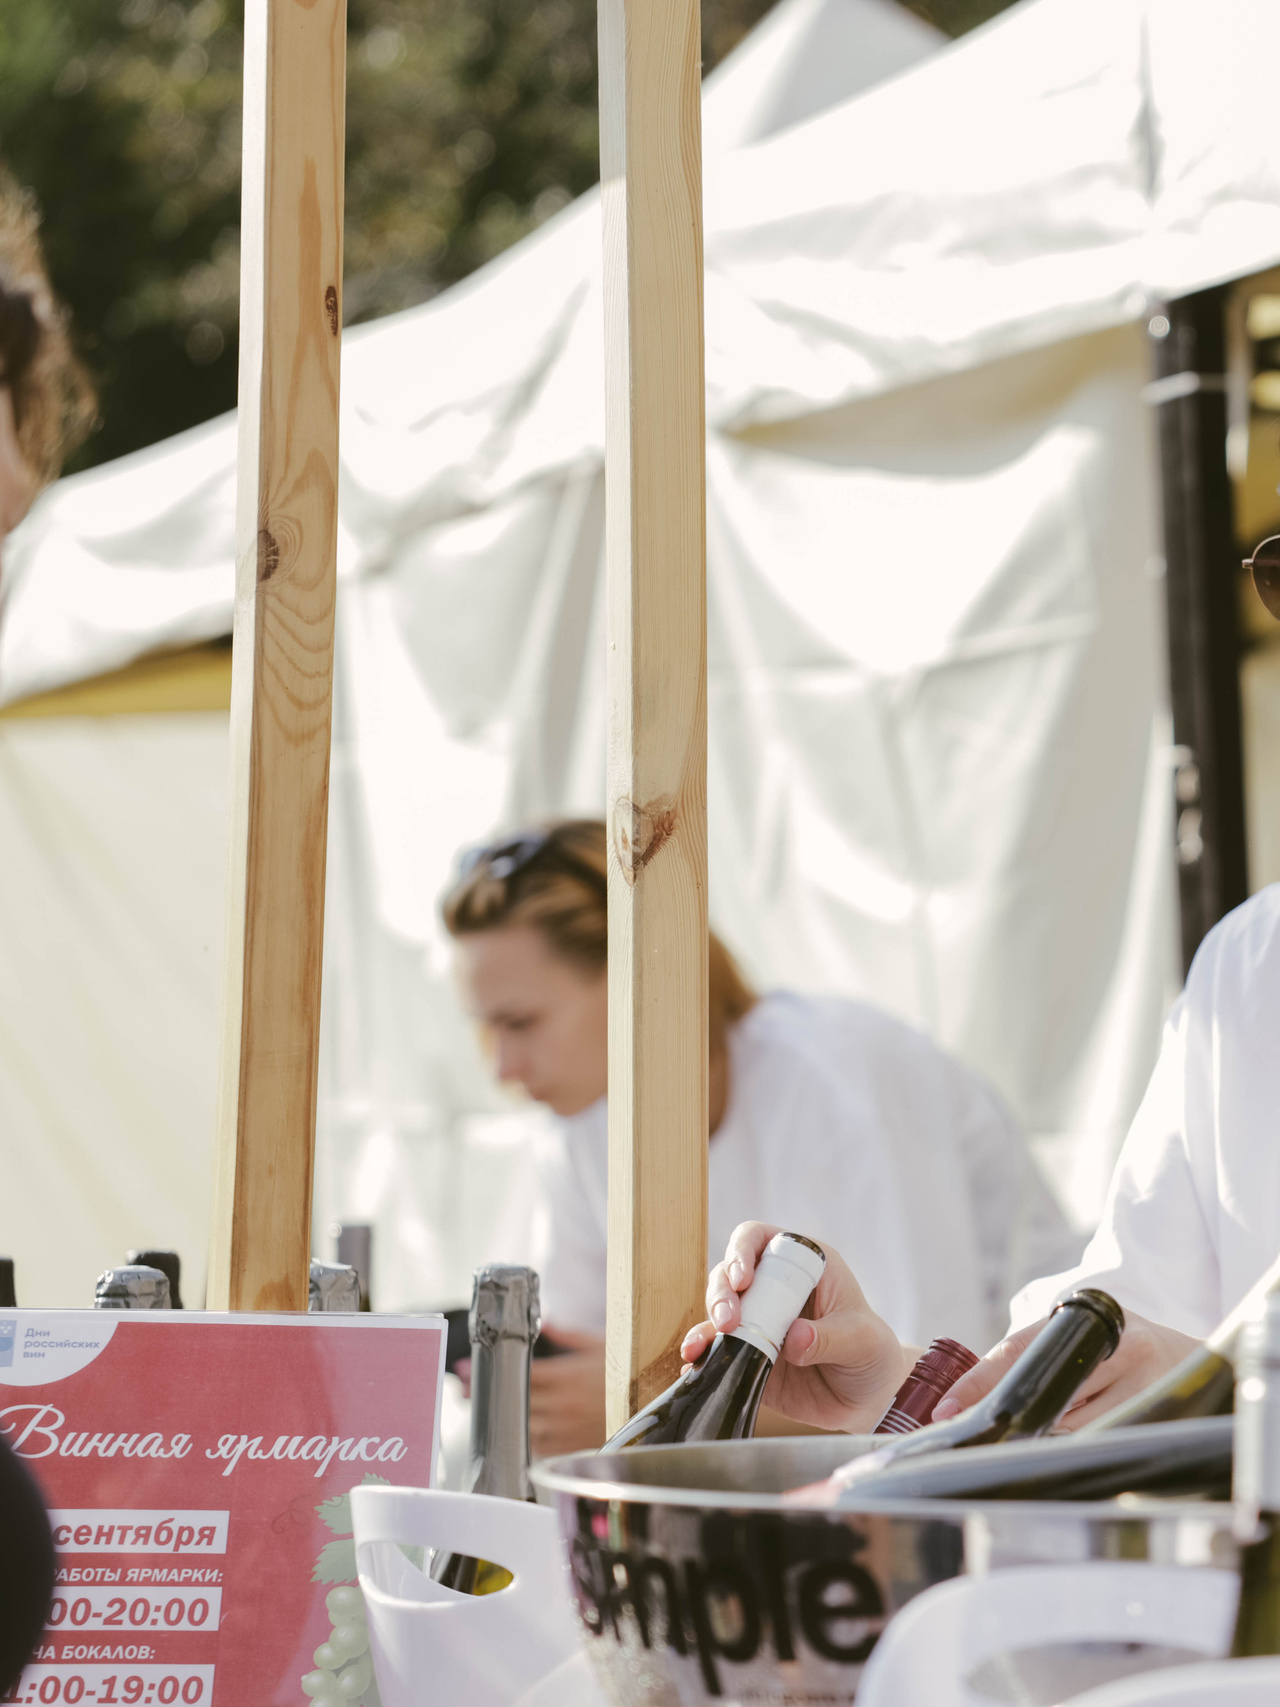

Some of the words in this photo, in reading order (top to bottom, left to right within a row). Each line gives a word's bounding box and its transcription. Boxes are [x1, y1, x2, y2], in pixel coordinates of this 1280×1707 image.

[25, 1328, 50, 1338] Дни
[24, 1340, 100, 1349] российских
[0, 1403, 193, 1459] Винная
[205, 1433, 408, 1477] ярмарка
[53, 1518, 217, 1552] сентября
[54, 1568, 121, 1582] АБОТЫ
[125, 1568, 224, 1583] ЯРМАРКИ:
[61, 1645, 156, 1660] БОКАЛОВ:
